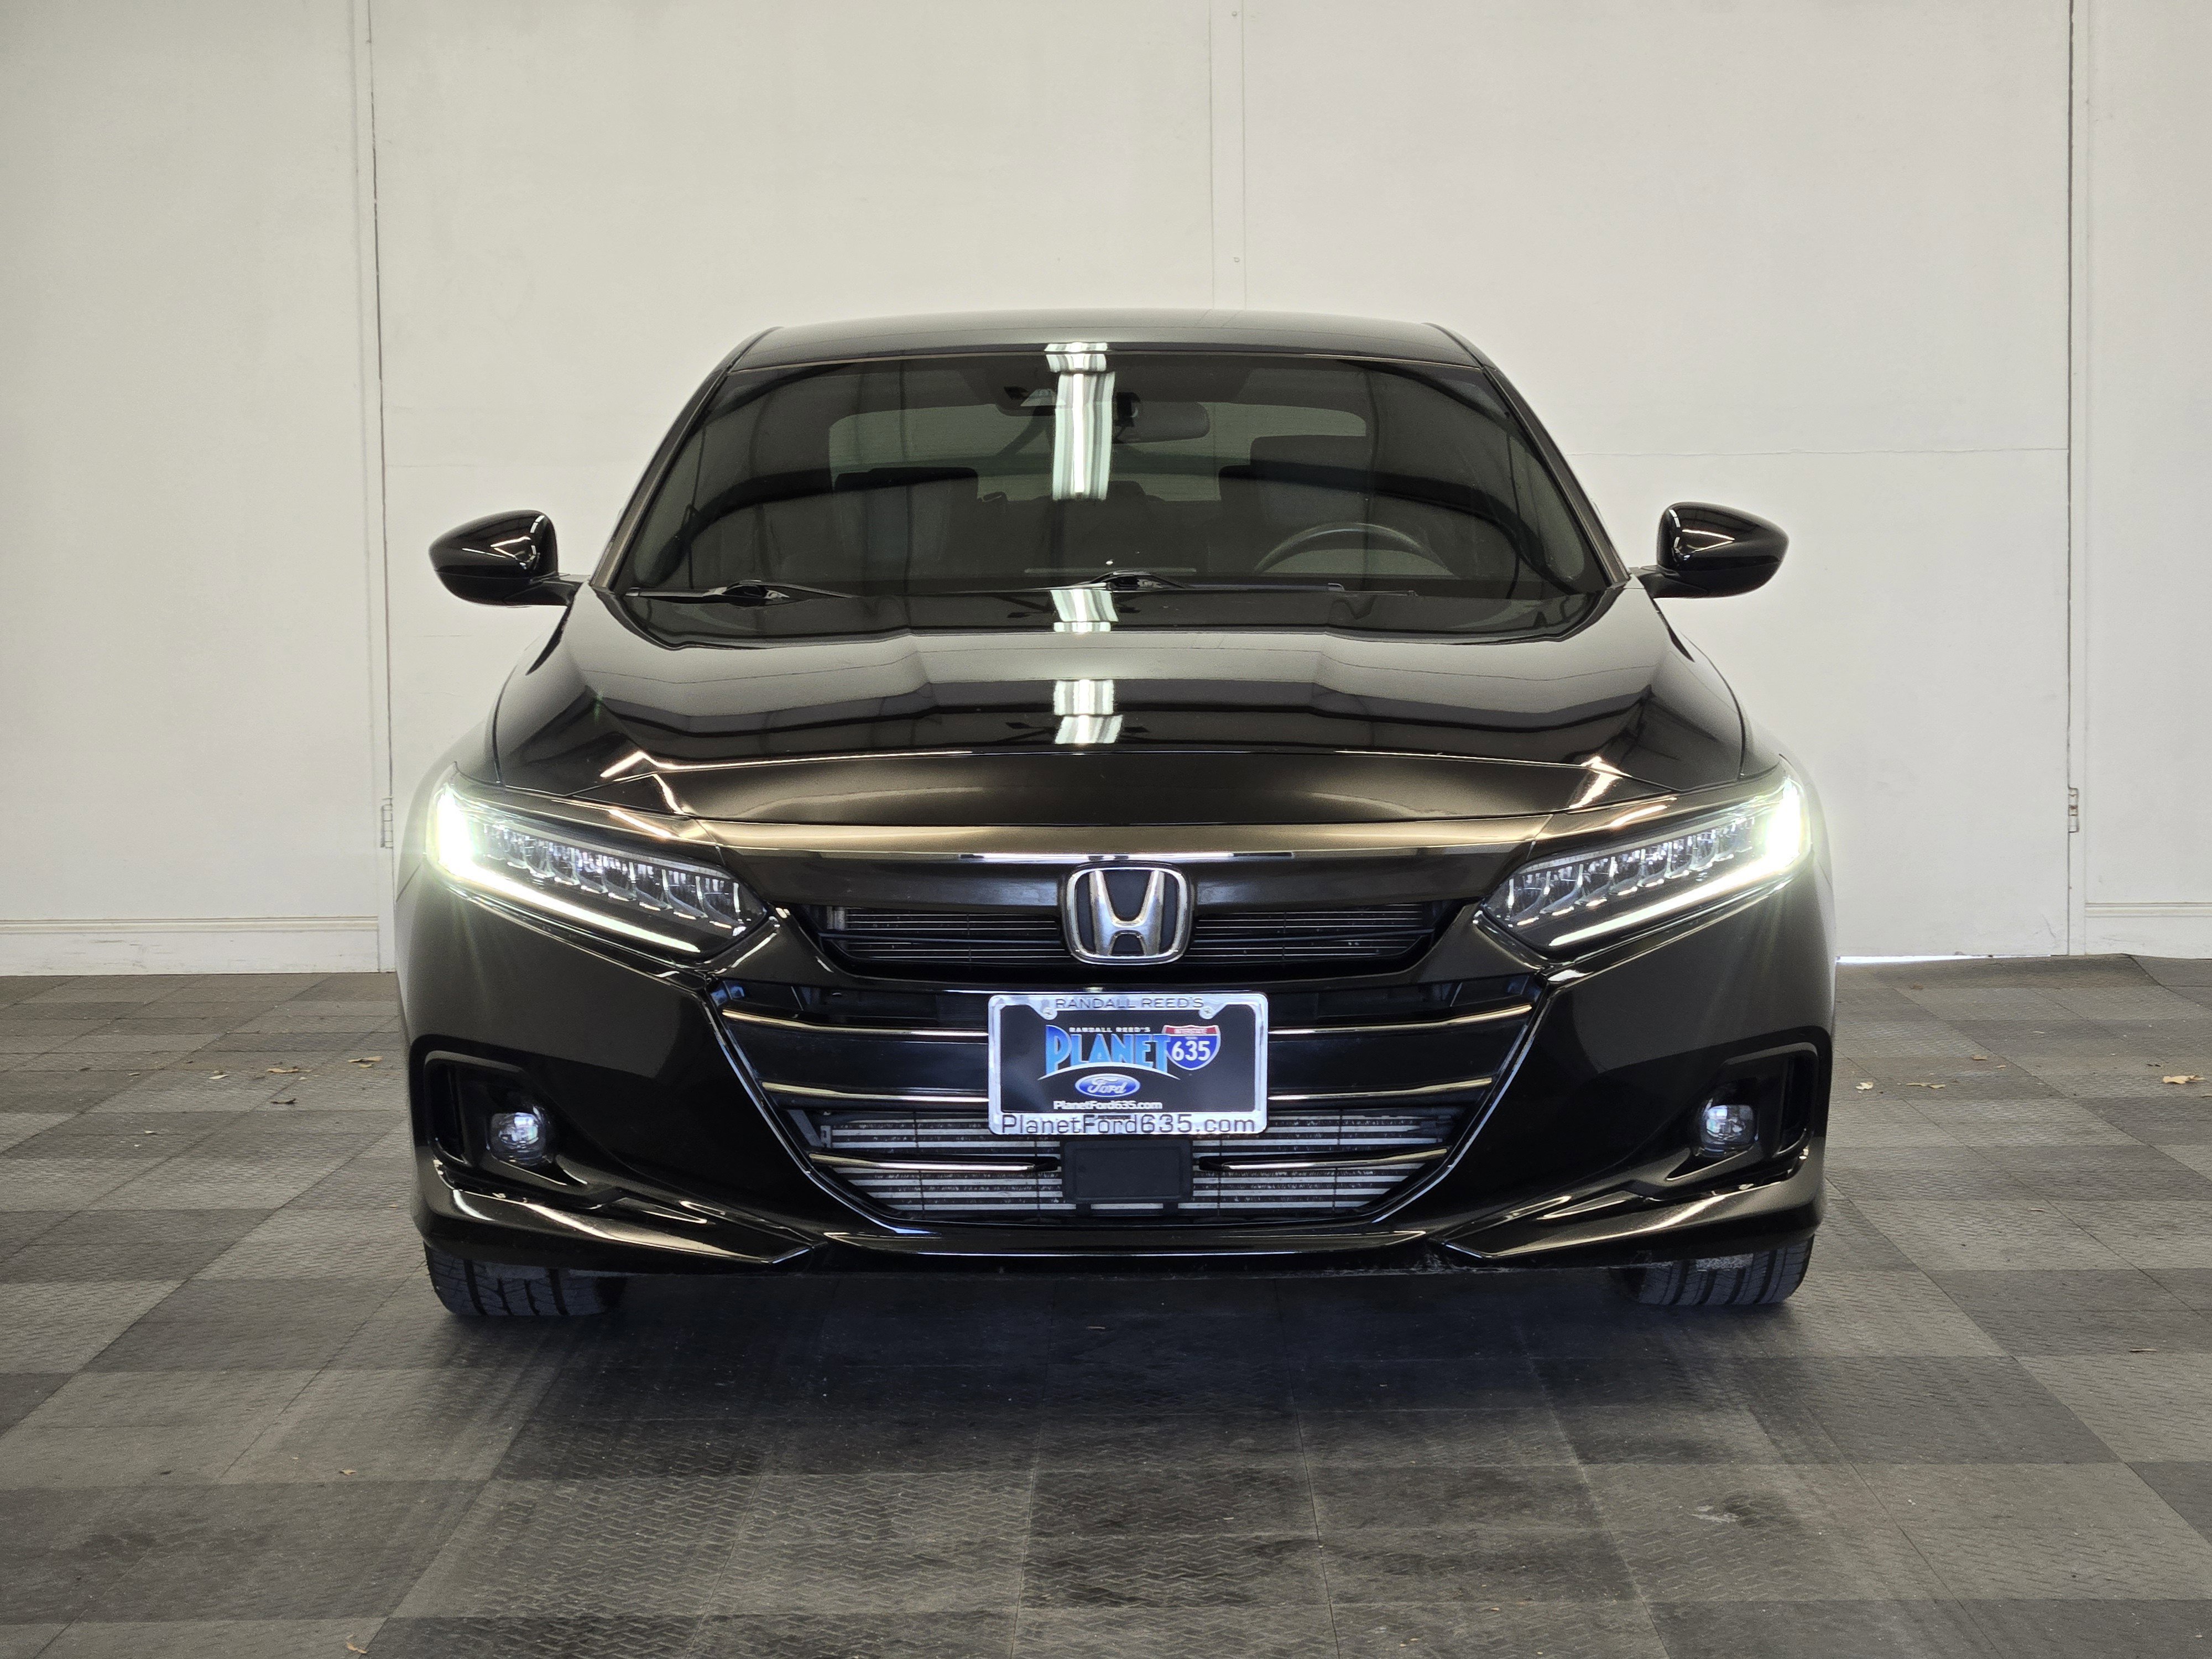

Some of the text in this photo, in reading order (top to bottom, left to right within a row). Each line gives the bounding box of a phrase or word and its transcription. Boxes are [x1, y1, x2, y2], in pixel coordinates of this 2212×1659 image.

[1056, 998, 1204, 1008] RANDALL REED'S
[1045, 1025, 1171, 1074] PLANET
[1172, 1040, 1211, 1061] 635
[1087, 1078, 1127, 1093] Ford
[1053, 1100, 1162, 1109] PlanetFord635.com
[1002, 1114, 1255, 1133] PlanetFord635.com
